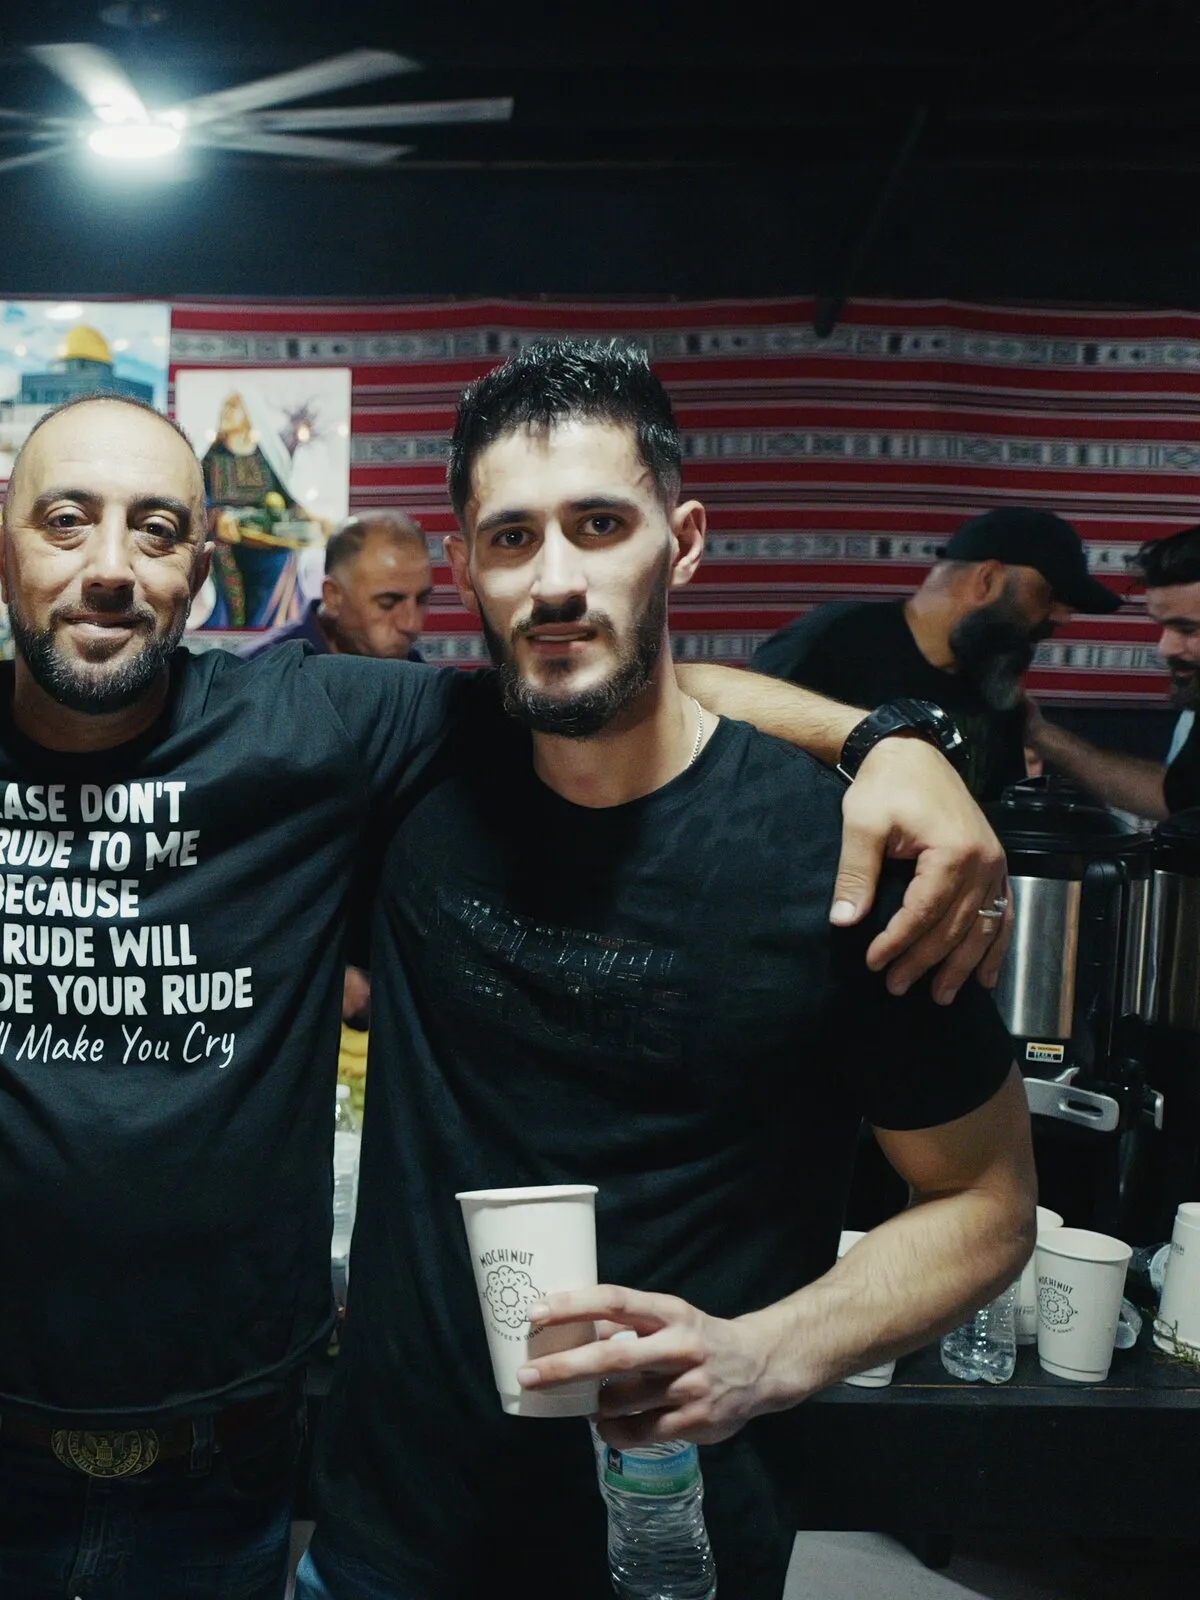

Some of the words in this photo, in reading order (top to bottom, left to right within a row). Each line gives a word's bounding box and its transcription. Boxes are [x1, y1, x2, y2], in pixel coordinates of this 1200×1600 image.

[80, 781, 186, 824] DON'T
[87, 831, 131, 871] TO
[145, 829, 200, 871] ME
[3, 923, 95, 967] RUDE
[108, 924, 197, 968] WILL
[48, 974, 148, 1016] YOUR
[162, 967, 253, 1016] RUDE
[15, 1024, 104, 1063] Make
[121, 1024, 169, 1064] You
[182, 1021, 236, 1069] Cry
[479, 1249, 534, 1268] MOCHINUT
